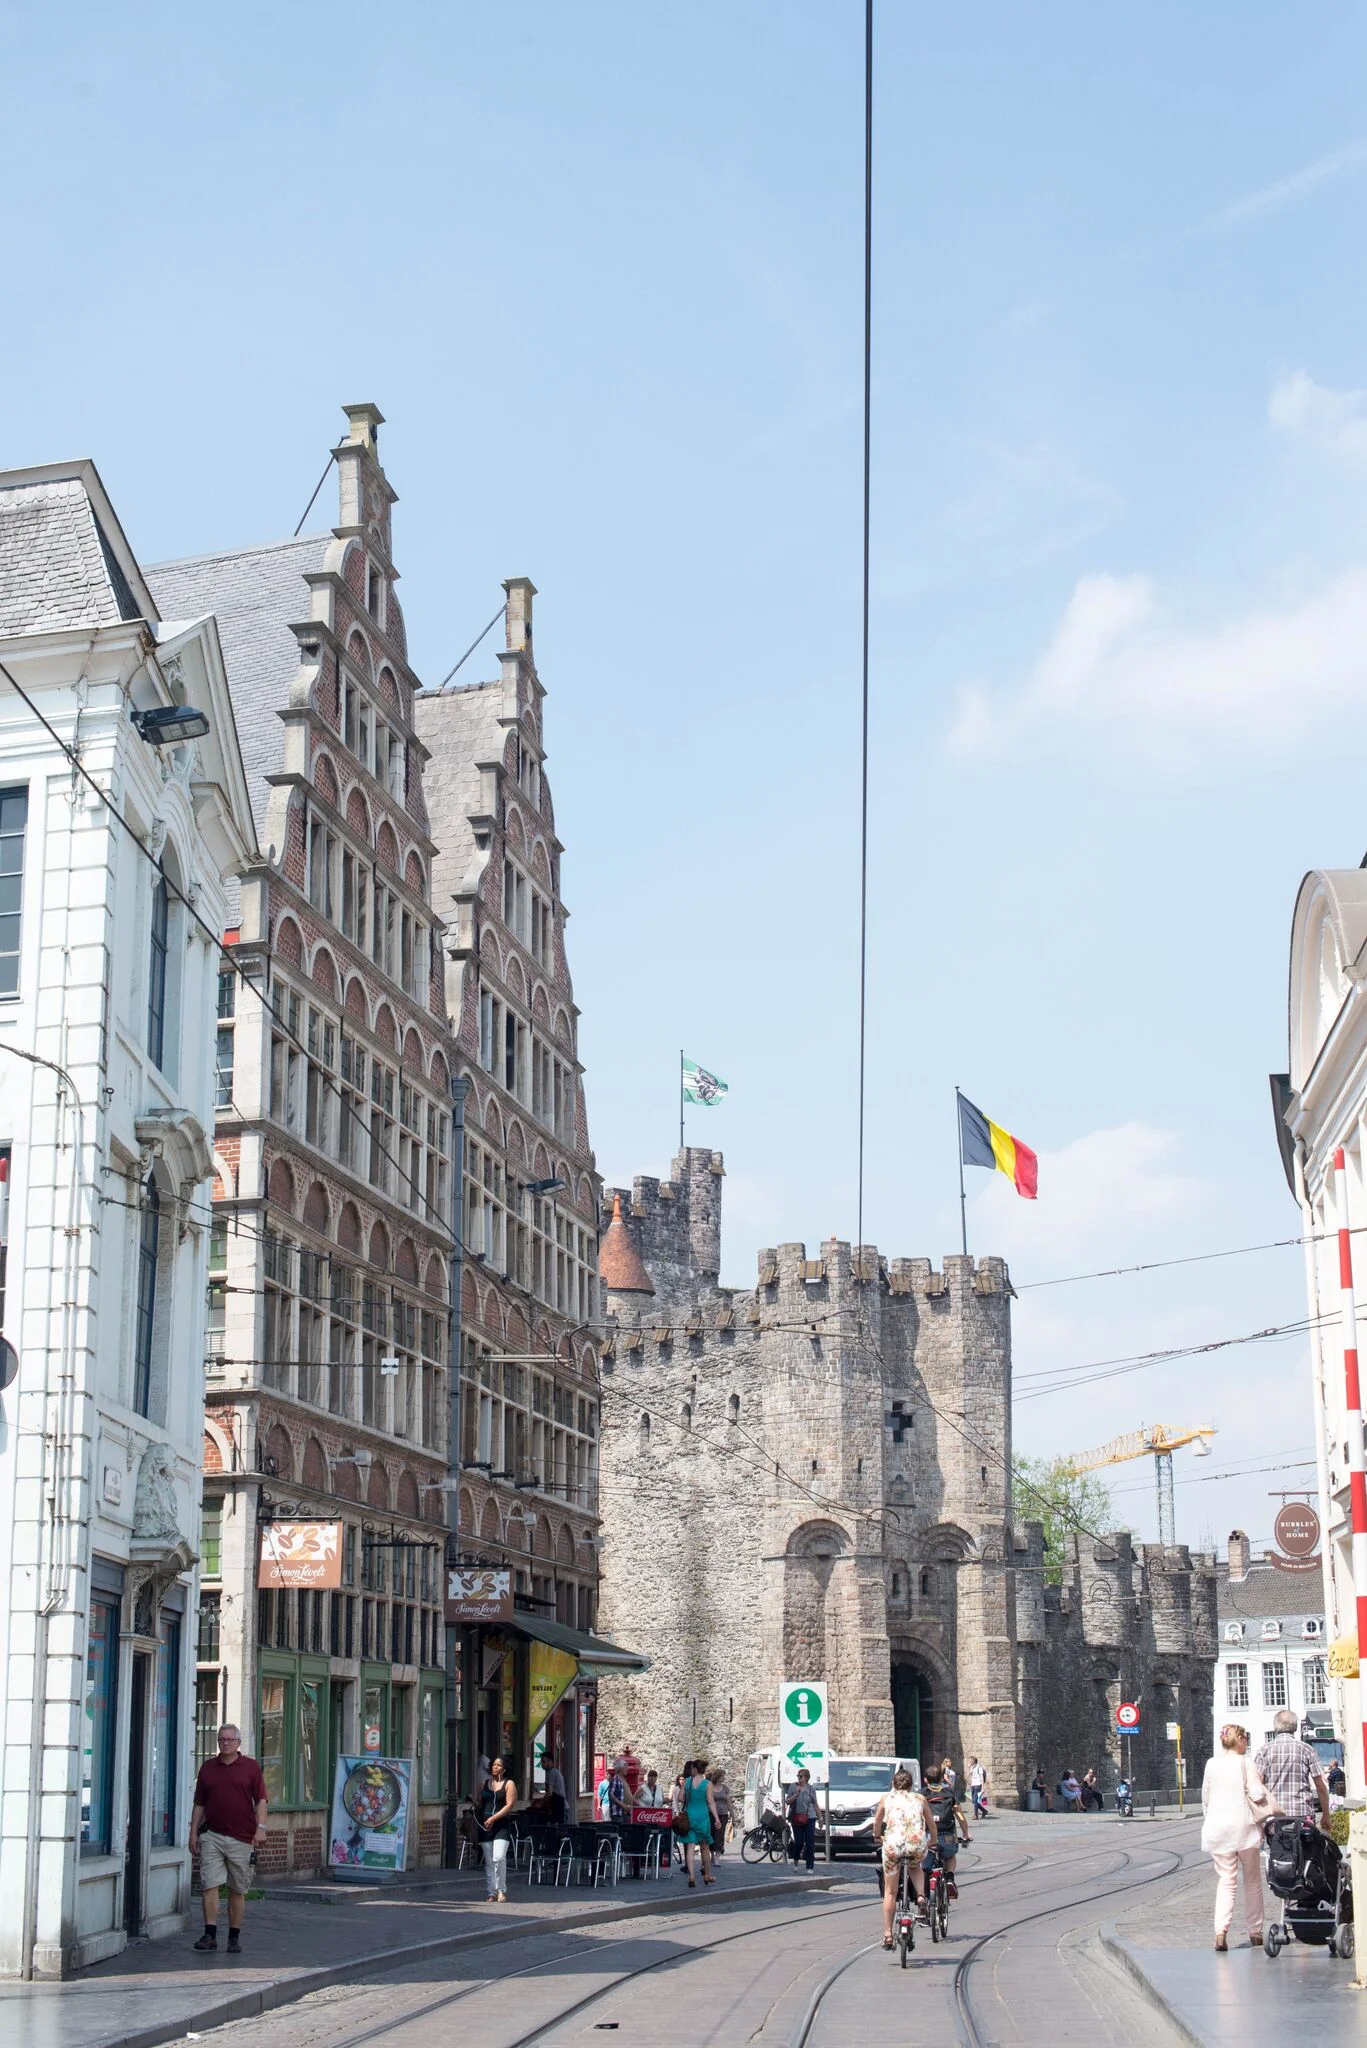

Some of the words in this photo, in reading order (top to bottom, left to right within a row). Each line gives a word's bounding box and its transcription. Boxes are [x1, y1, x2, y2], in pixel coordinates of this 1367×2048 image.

[270, 1564, 301, 1579] Simon
[455, 1602, 480, 1614] Simon
[637, 1811, 668, 1823] Coca-Cola
